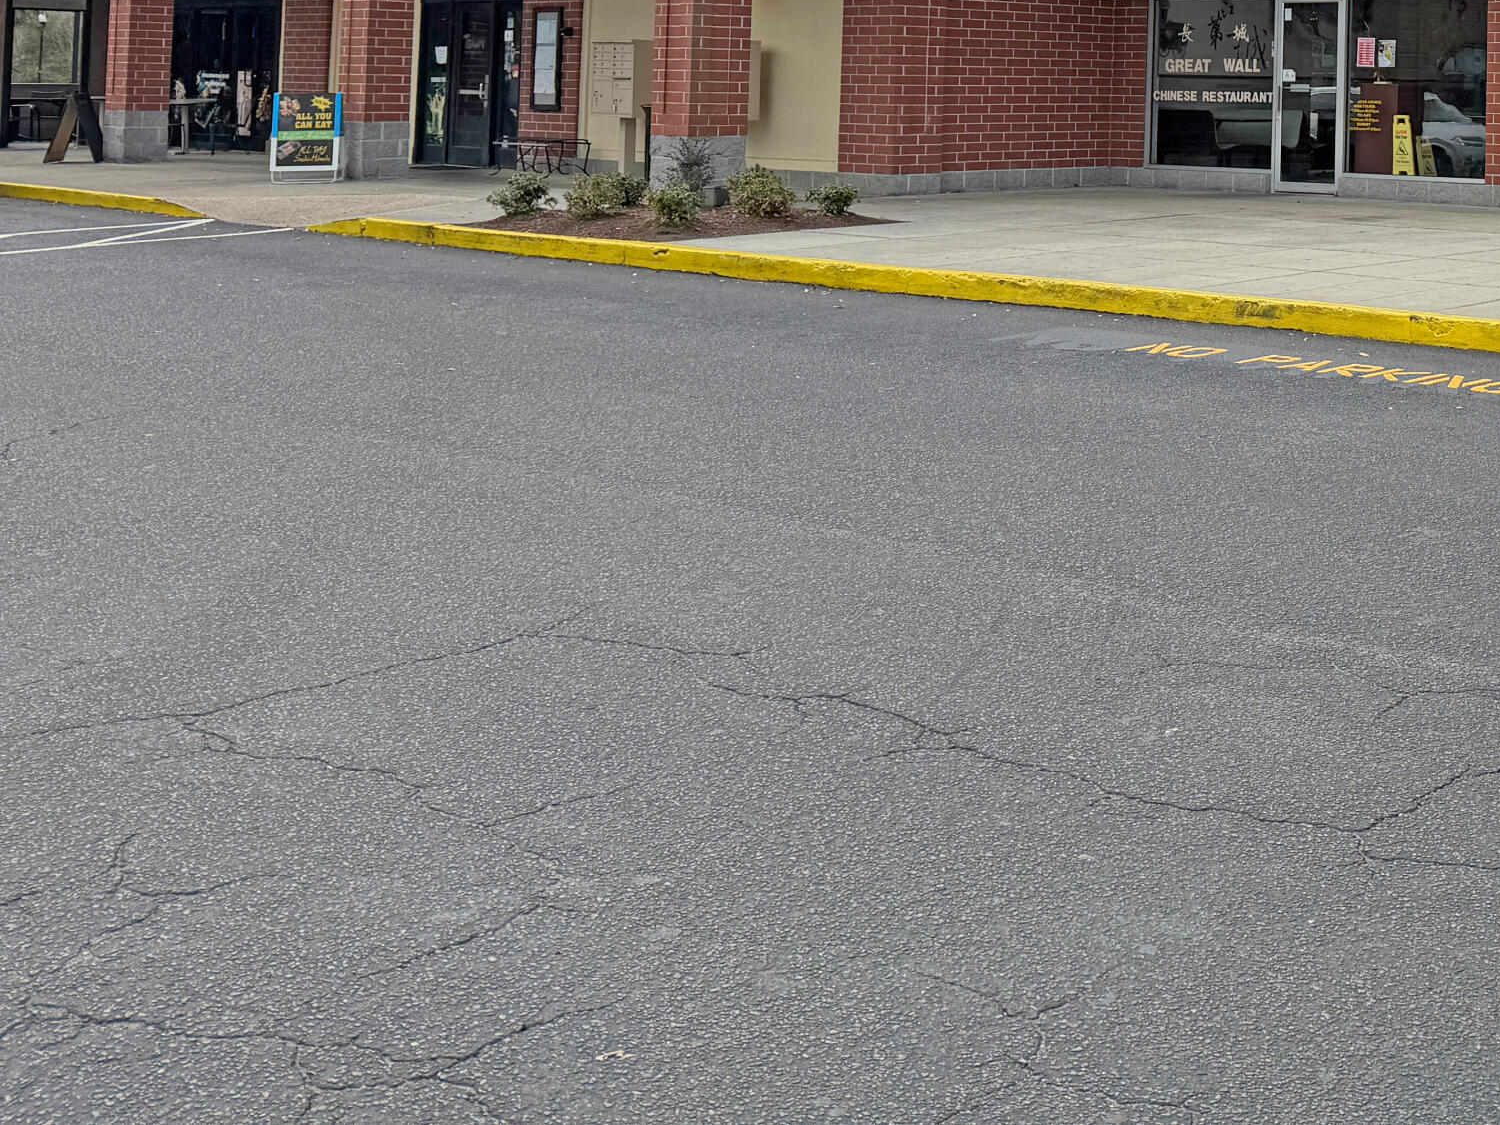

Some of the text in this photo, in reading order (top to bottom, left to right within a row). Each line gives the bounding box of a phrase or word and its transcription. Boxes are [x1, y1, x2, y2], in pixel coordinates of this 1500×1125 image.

[1164, 58, 1261, 73] GREAT WALL
[1153, 90, 1273, 104] CHINESE RESTAURANT
[315, 112, 332, 120] YOU
[1126, 342, 1228, 358] NO
